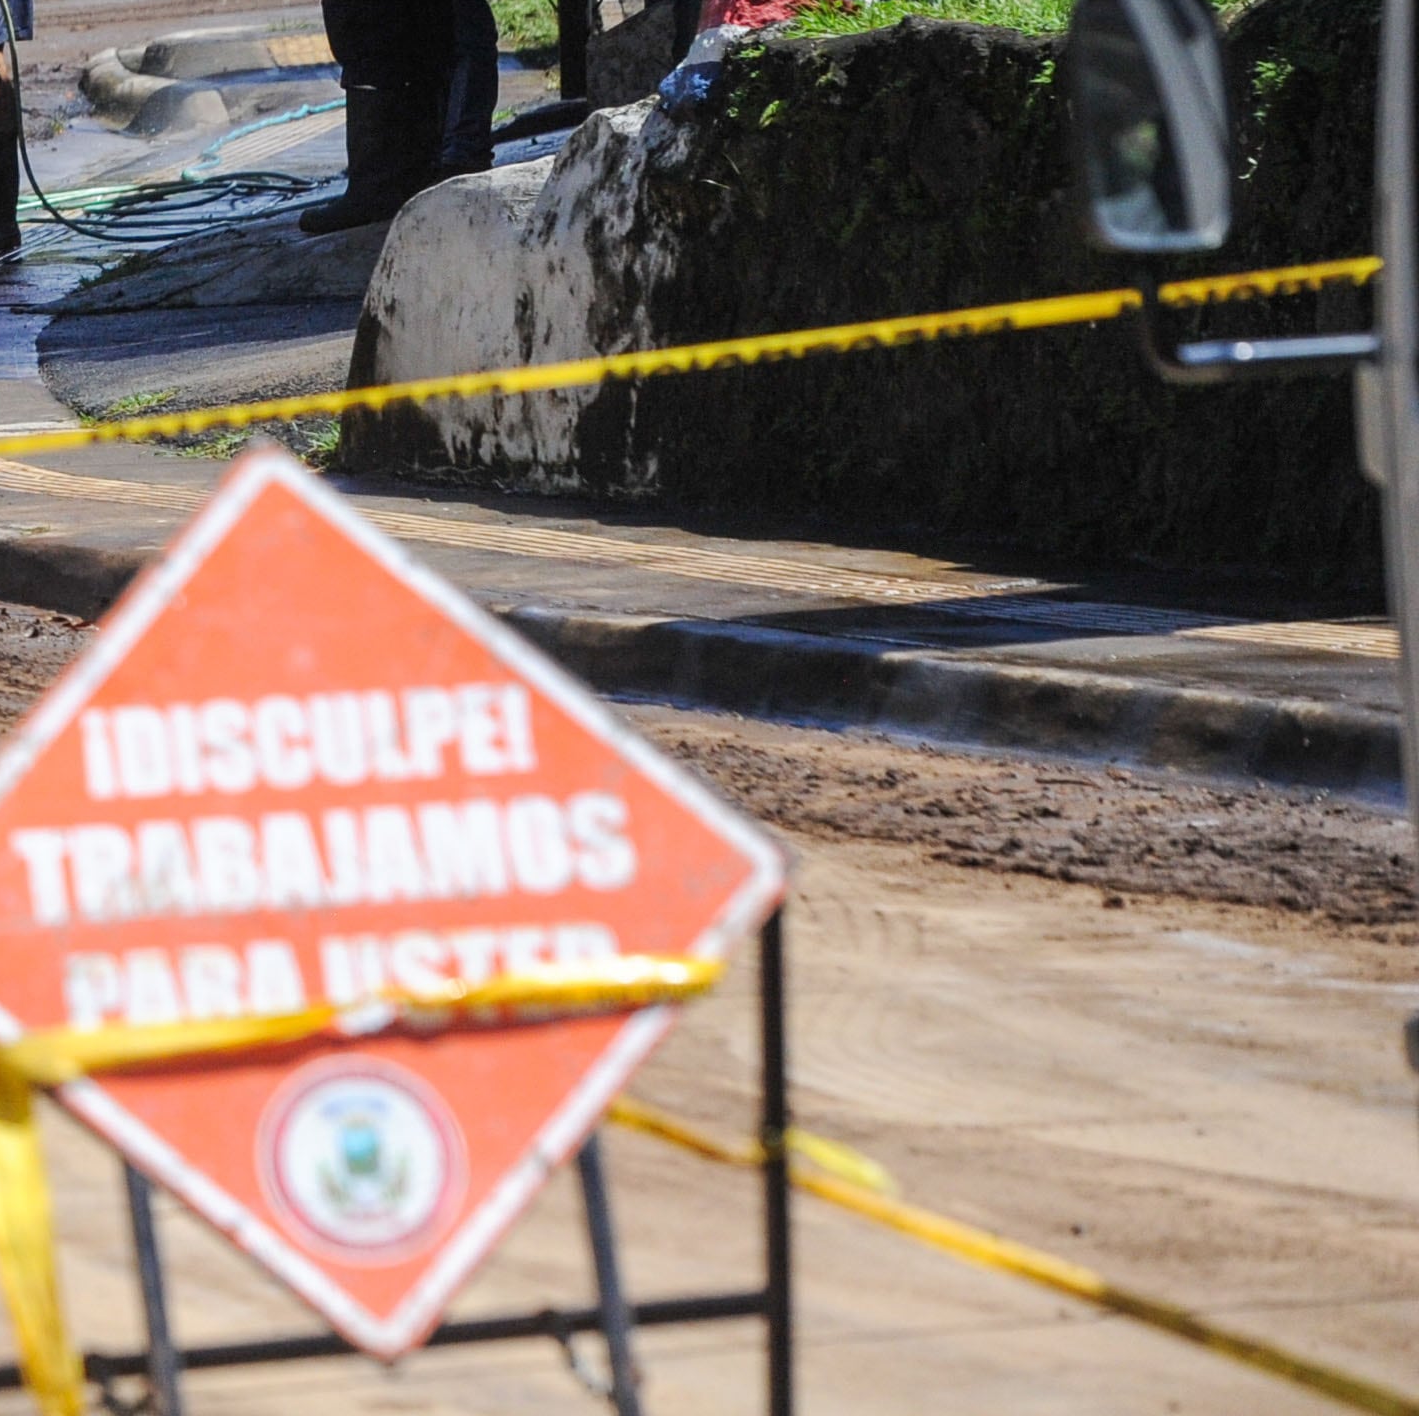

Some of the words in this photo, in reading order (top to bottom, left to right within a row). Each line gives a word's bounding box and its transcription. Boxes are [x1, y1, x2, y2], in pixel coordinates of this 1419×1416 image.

[84, 685, 534, 796] ¡DISCULPE!
[13, 794, 635, 923] TRABAJAMOS
[65, 940, 308, 1031] PARA
